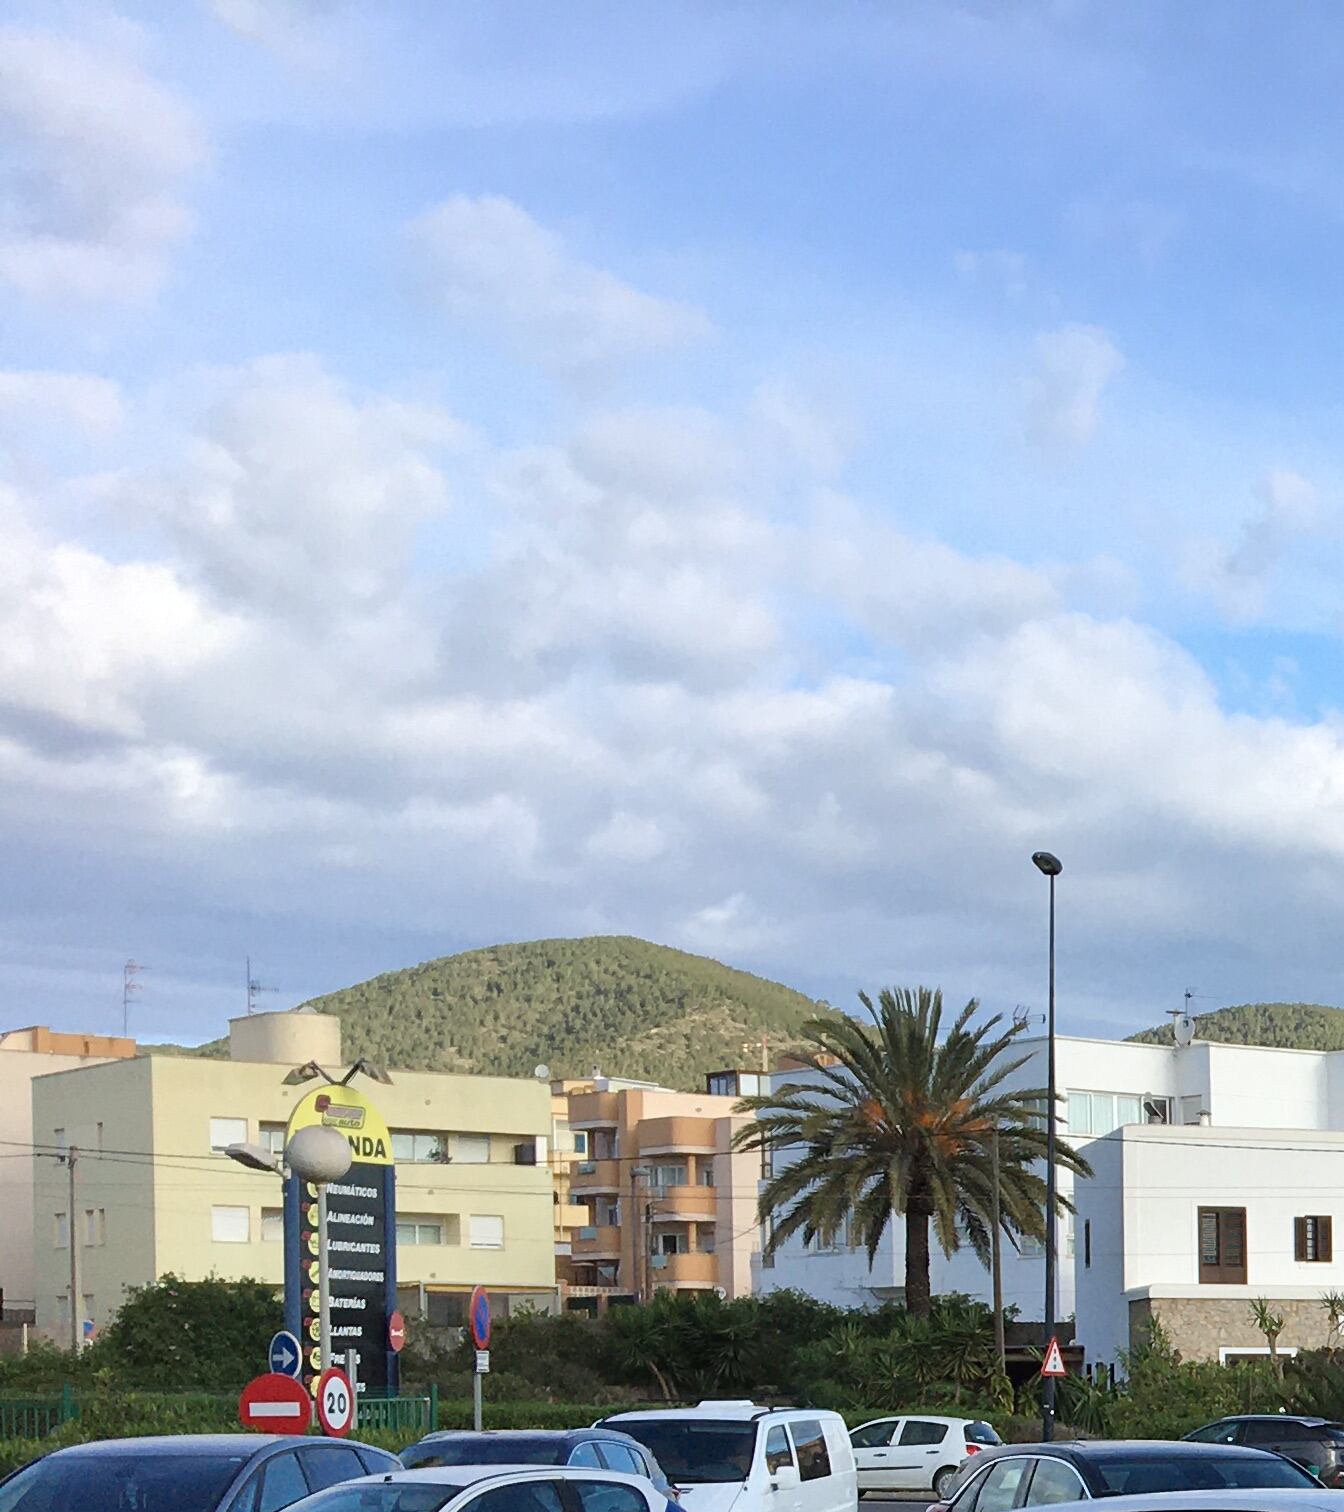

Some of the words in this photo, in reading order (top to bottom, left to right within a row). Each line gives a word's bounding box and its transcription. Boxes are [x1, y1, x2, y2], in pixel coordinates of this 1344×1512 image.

[326, 1211, 375, 1225] ALINEACIÓN
[327, 1239, 381, 1254] LUBRICANTES
[327, 1392, 347, 1414] 20
